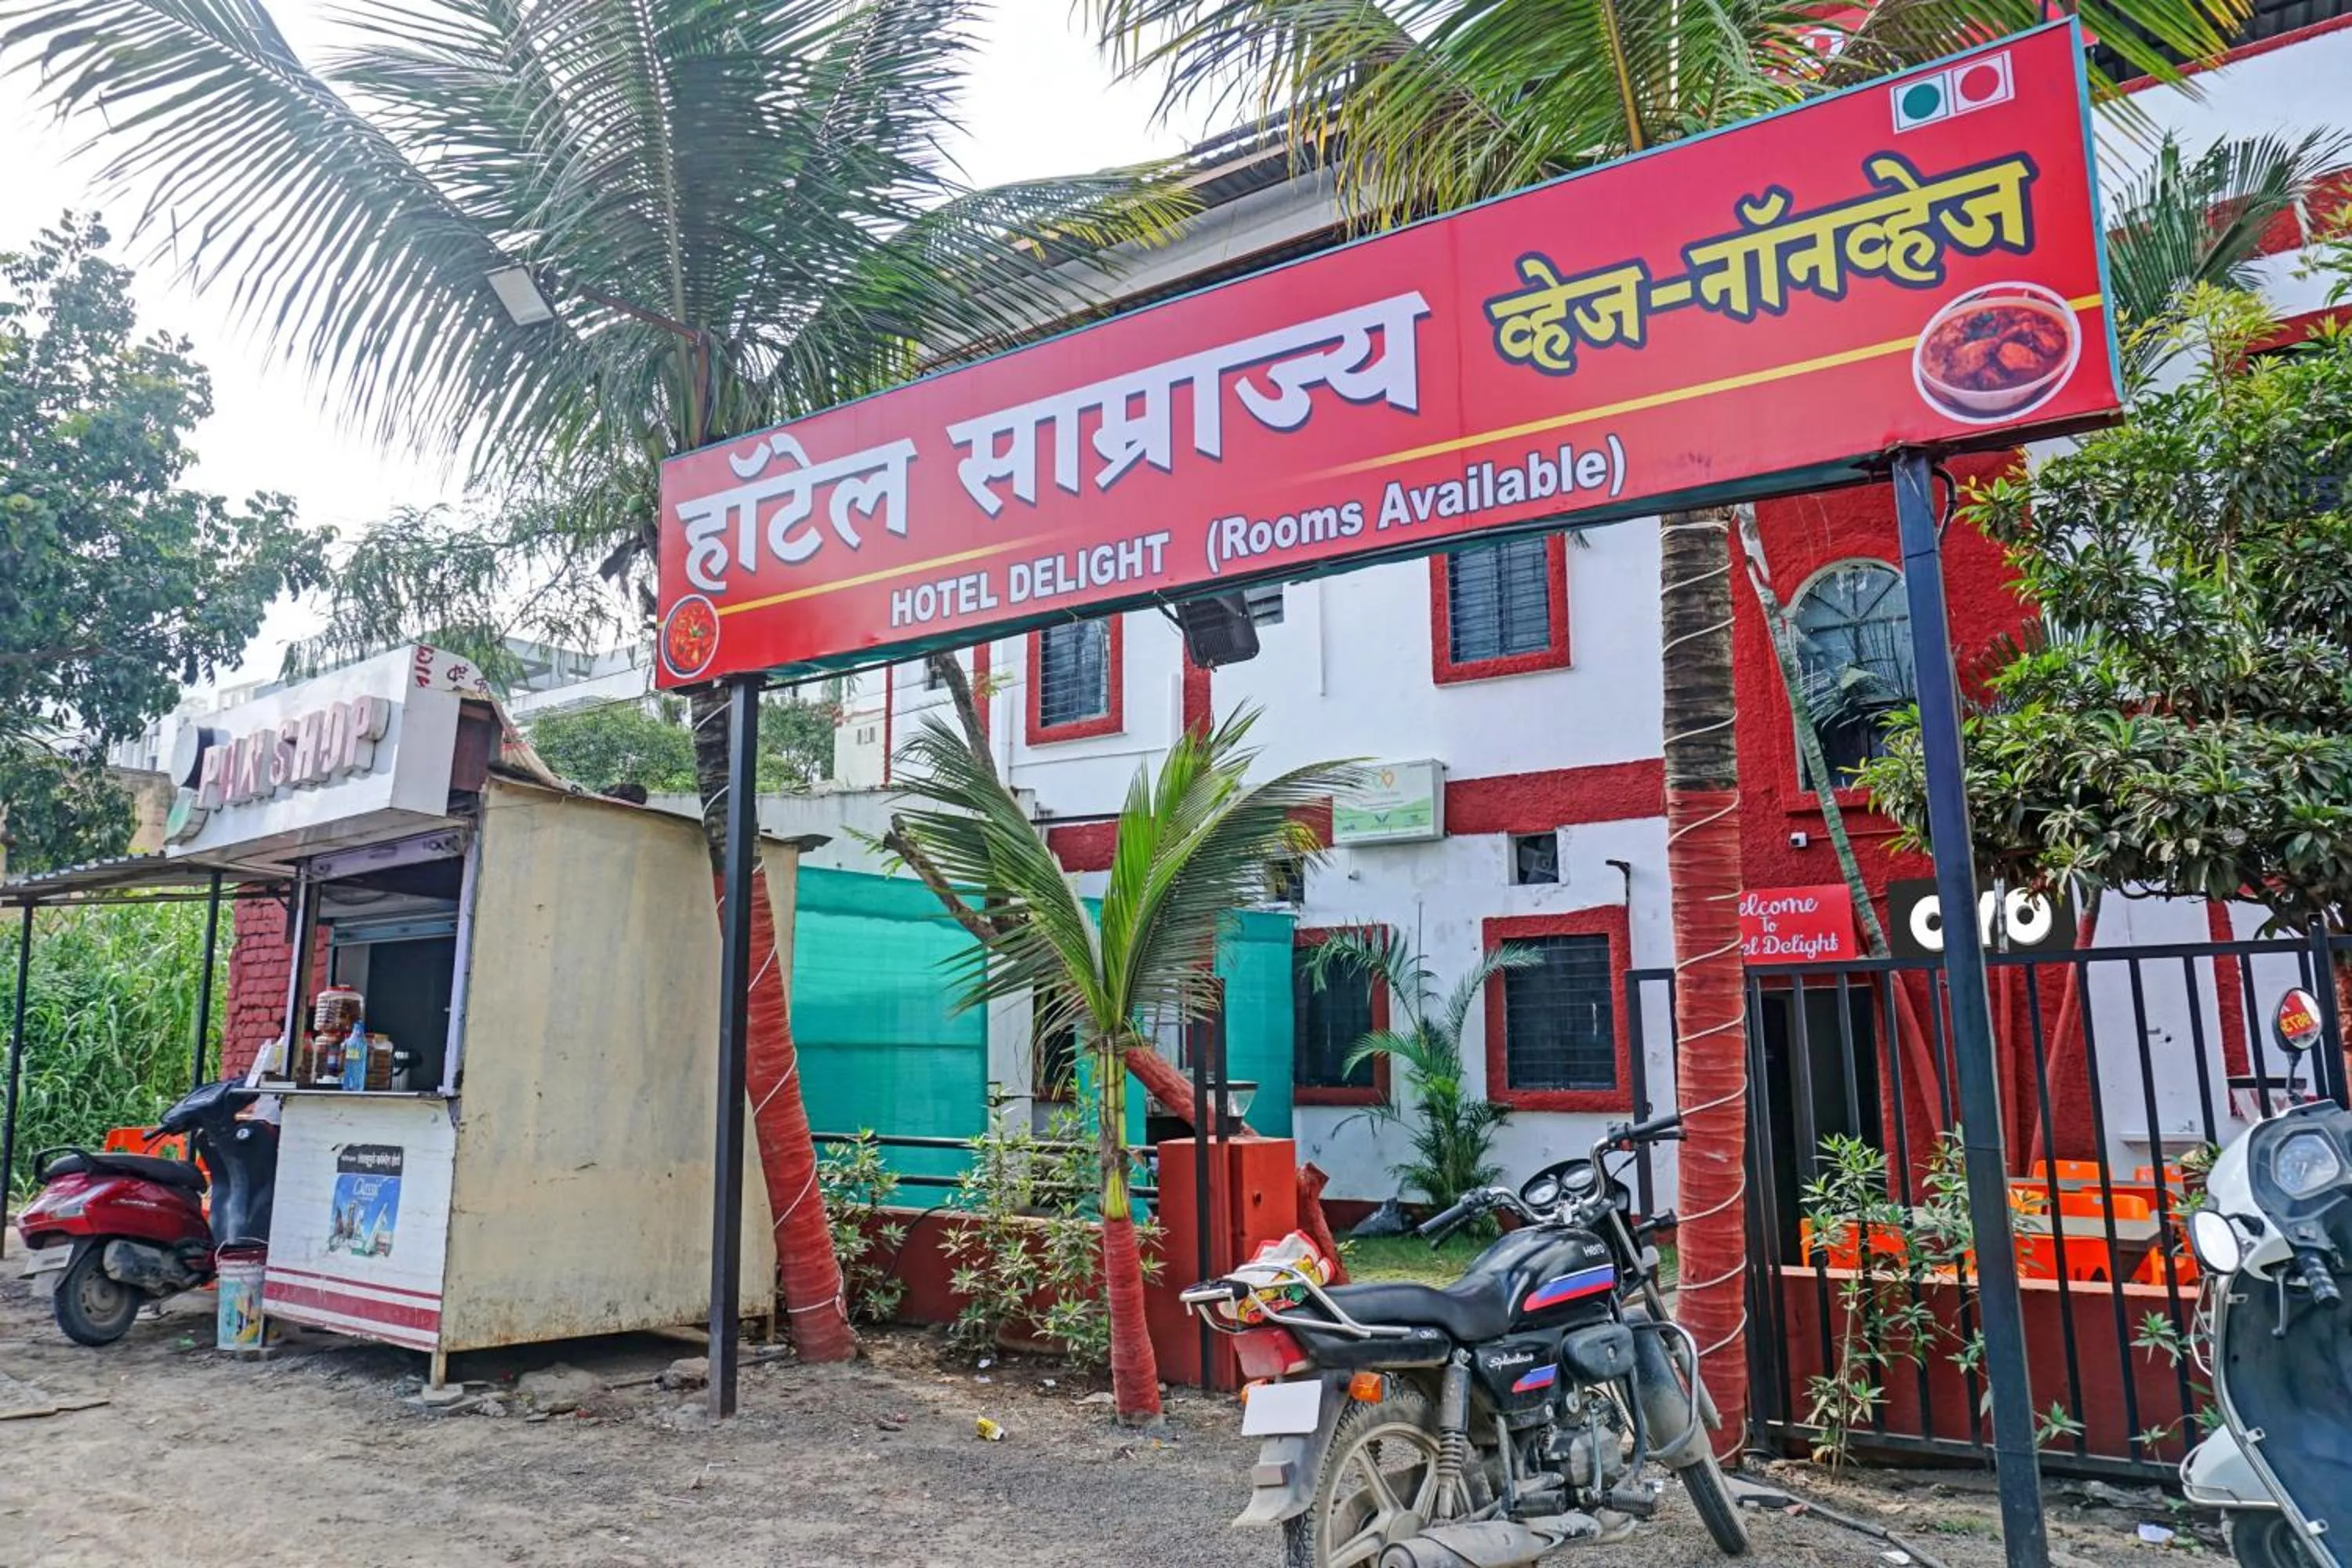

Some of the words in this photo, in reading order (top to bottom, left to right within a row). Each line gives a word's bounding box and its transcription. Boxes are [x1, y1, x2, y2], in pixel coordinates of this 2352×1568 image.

[676, 433, 918, 591] हॉटेल
[946, 290, 1430, 516] साम्राज्य
[891, 572, 998, 627] HOTEL
[1009, 532, 1170, 603] DELIGHT
[1207, 499, 1363, 573] (Rooms
[1377, 435, 1625, 529] Available)
[270, 695, 389, 786] SHOP
[1739, 893, 1819, 916] elcome
[1759, 916, 1777, 932] To
[1762, 931, 1838, 960] Delight
